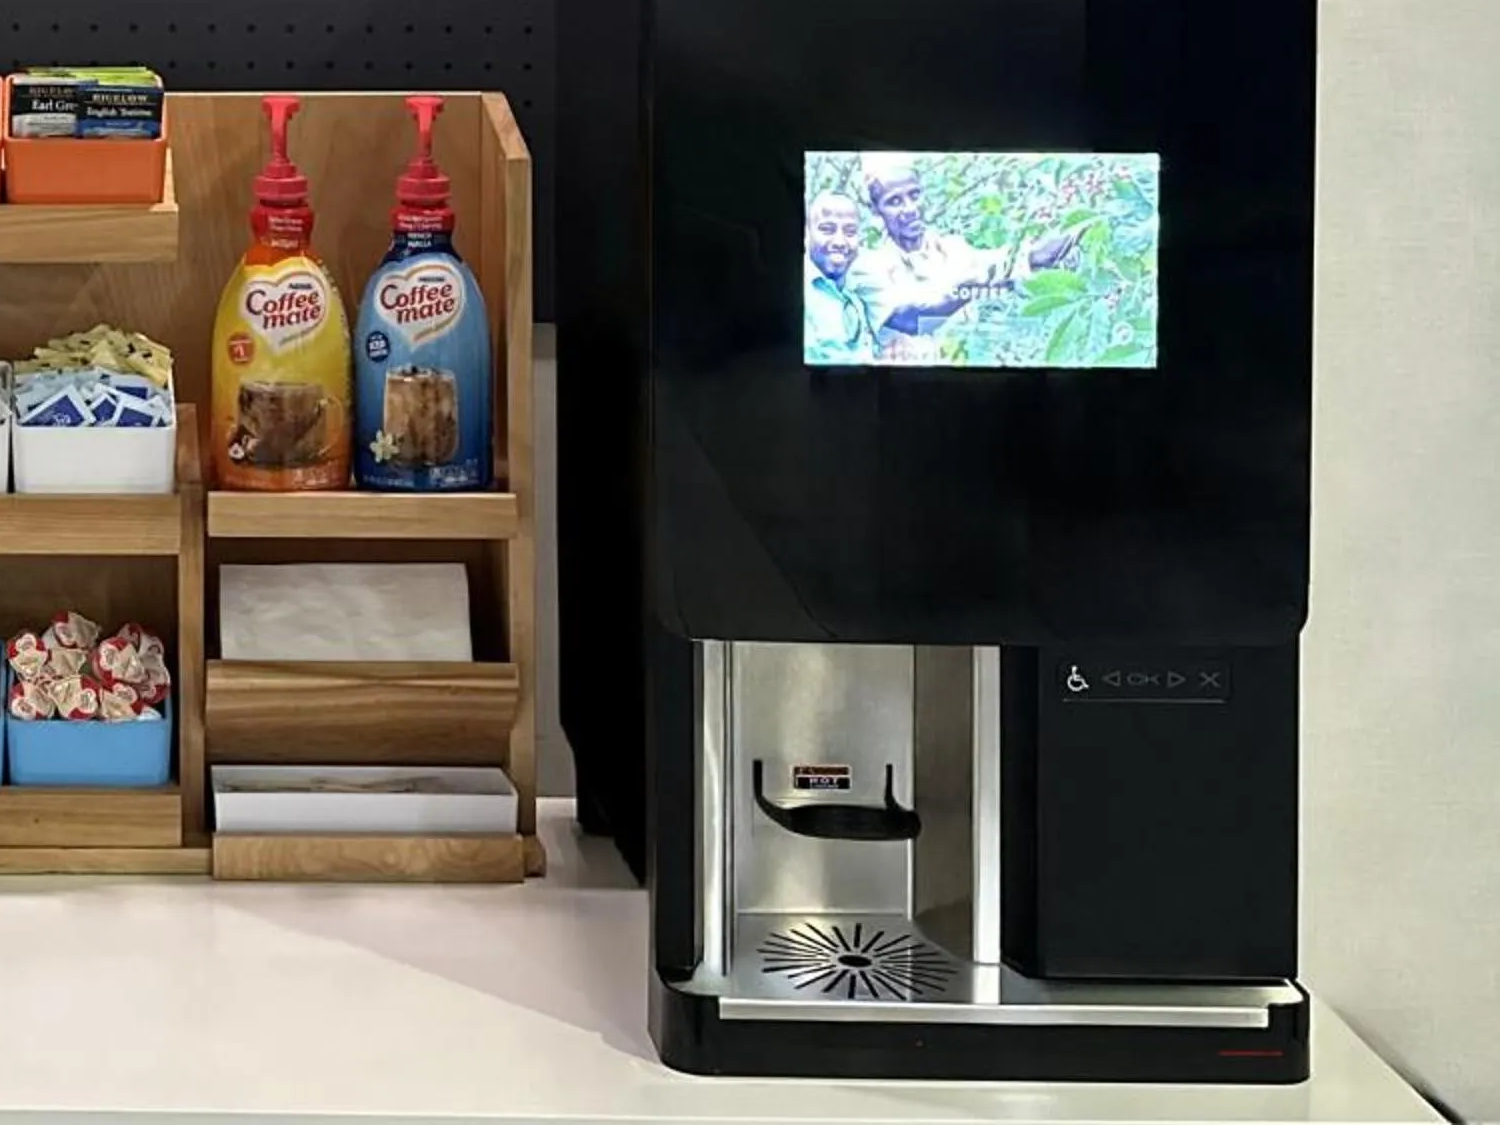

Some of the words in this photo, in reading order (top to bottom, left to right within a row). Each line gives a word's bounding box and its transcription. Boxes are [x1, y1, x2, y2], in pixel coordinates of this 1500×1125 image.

[32, 99, 53, 111] Earl
[246, 289, 320, 315] Coffee
[381, 284, 453, 310] Coffee
[263, 306, 321, 330] mate
[396, 298, 454, 324] mate
